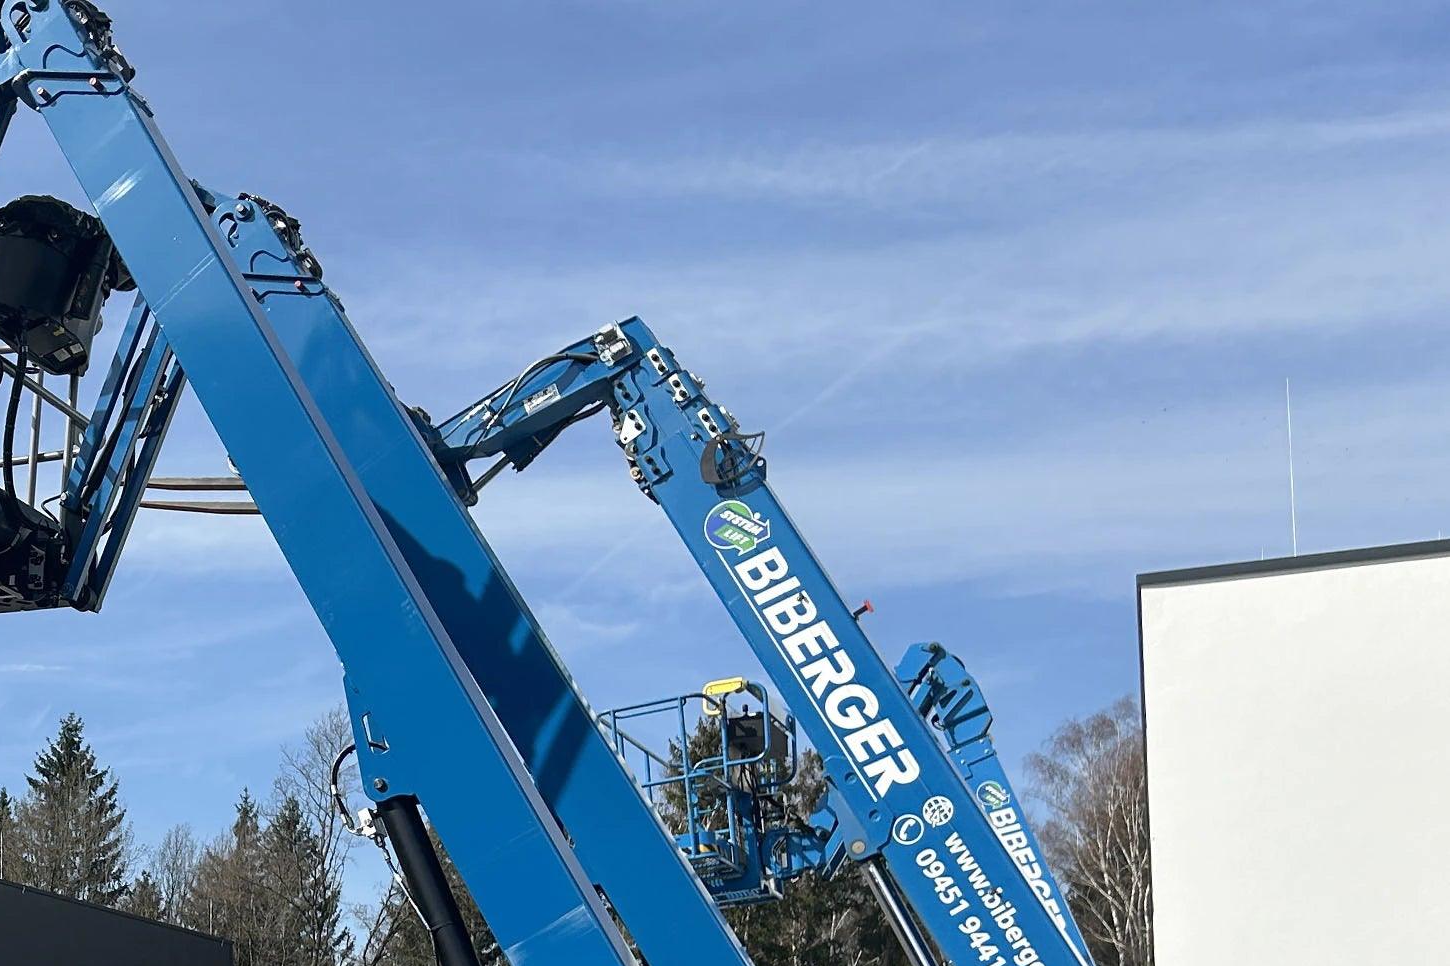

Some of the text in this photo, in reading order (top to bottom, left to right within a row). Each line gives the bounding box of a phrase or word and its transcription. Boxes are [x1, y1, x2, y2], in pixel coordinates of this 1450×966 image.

[720, 510, 764, 536] SYSTEM
[724, 529, 751, 544] LIFT
[734, 546, 920, 798] BIBERGER
[915, 848, 970, 917] 09451
